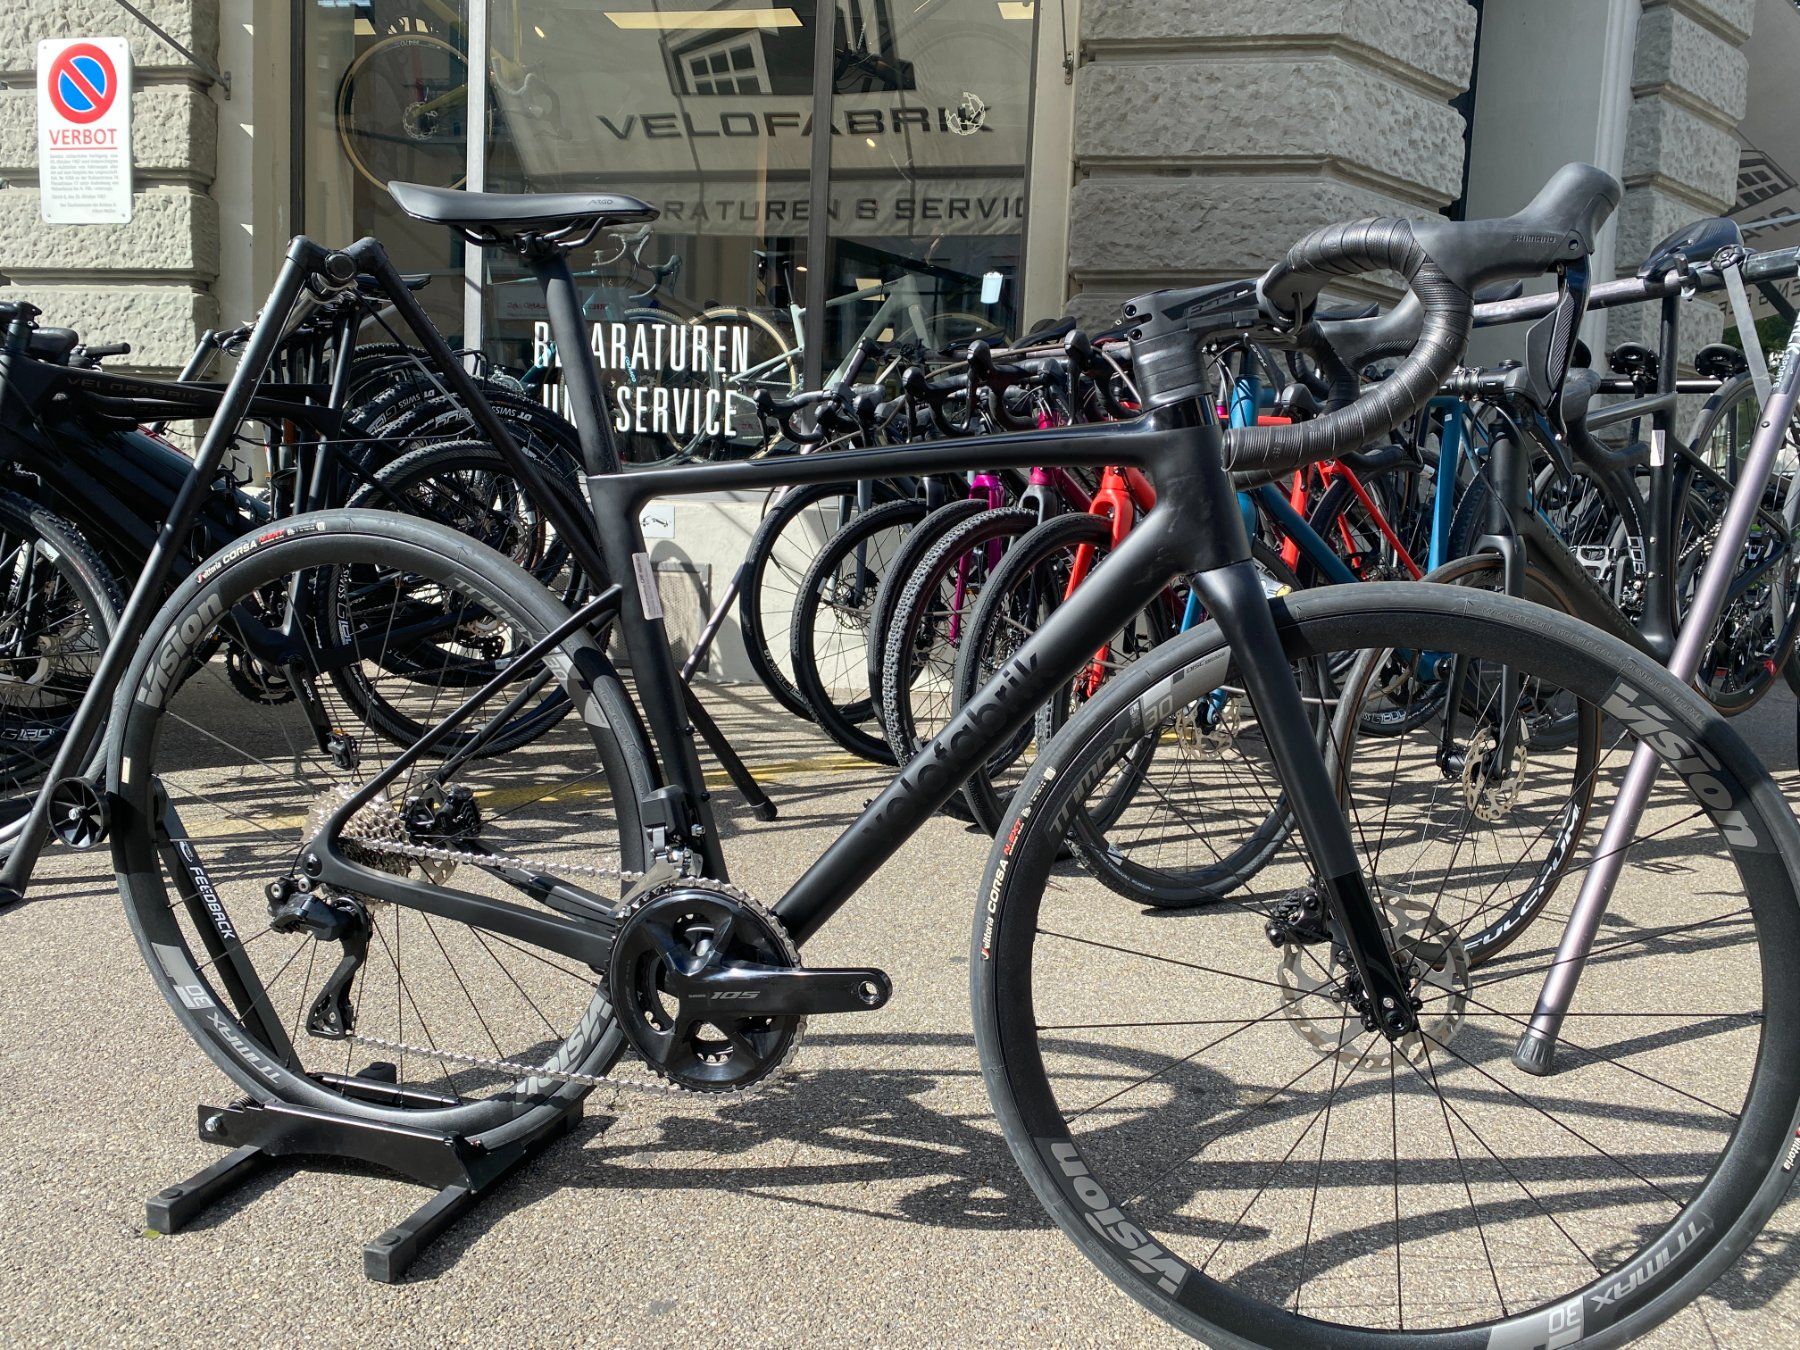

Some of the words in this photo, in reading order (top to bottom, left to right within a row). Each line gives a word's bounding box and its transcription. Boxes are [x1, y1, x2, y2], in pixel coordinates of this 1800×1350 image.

[49, 129, 117, 145] VERBOT
[534, 322, 749, 372] RARATUREN
[616, 385, 737, 436] SERVICE
[222, 540, 258, 564] CORSA
[137, 592, 224, 708] vision
[1144, 695, 1174, 731] 30
[1602, 682, 1758, 848] vision
[189, 866, 236, 940] FEEDBACK
[987, 860, 1009, 915] CORSA
[983, 918, 994, 950] vittoria
[710, 991, 760, 999] 105
[1050, 1142, 1189, 1296] vision
[1548, 1307, 1582, 1334] 30
